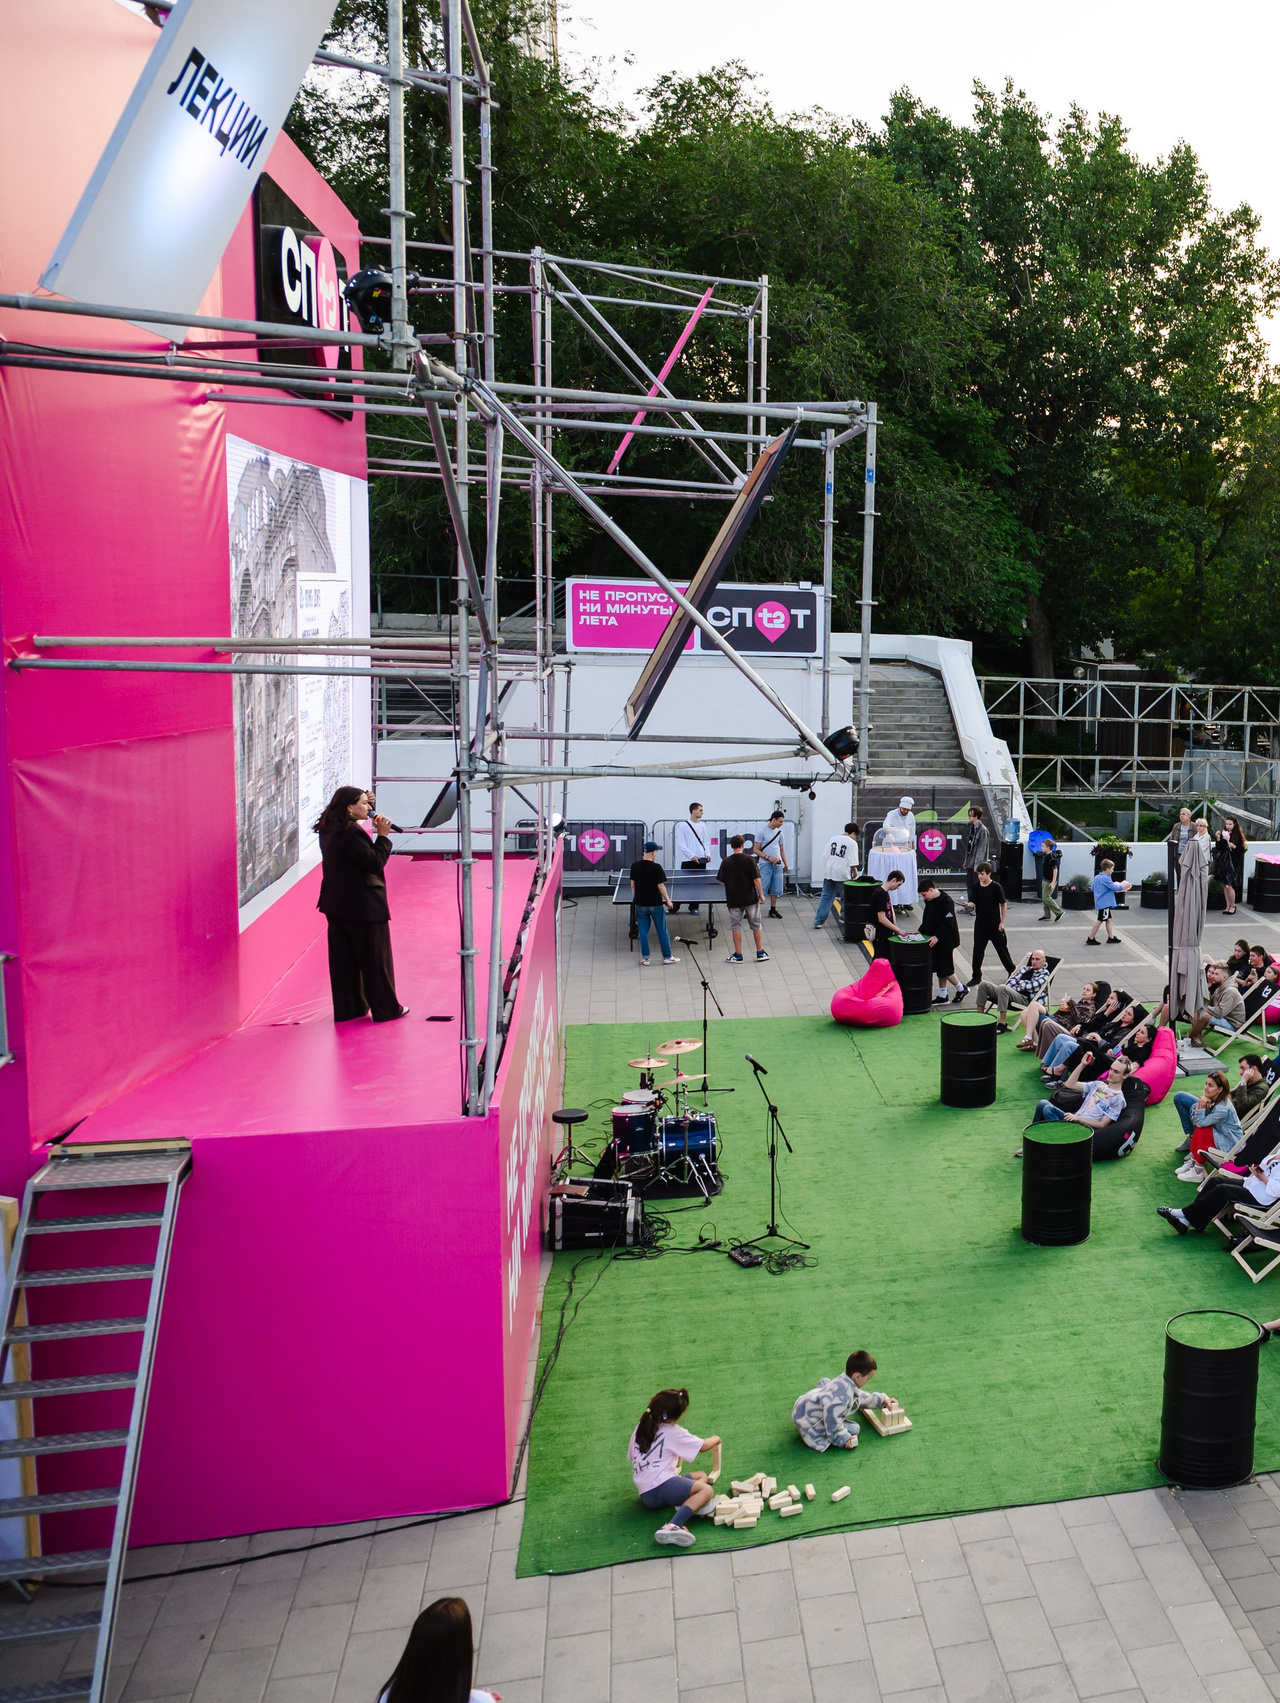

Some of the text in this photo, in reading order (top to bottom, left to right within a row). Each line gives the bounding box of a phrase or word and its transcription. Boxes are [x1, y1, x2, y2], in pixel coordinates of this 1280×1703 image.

[167, 46, 269, 170] ЛЕКЦИИ
[579, 590, 674, 603] НЕ ПРОПУС
[579, 603, 673, 615] НИ МИНУТЫ
[579, 615, 618, 626] ЛЕТА
[506, 1117, 519, 1235] НЕ
[508, 1207, 522, 1335] НИ
